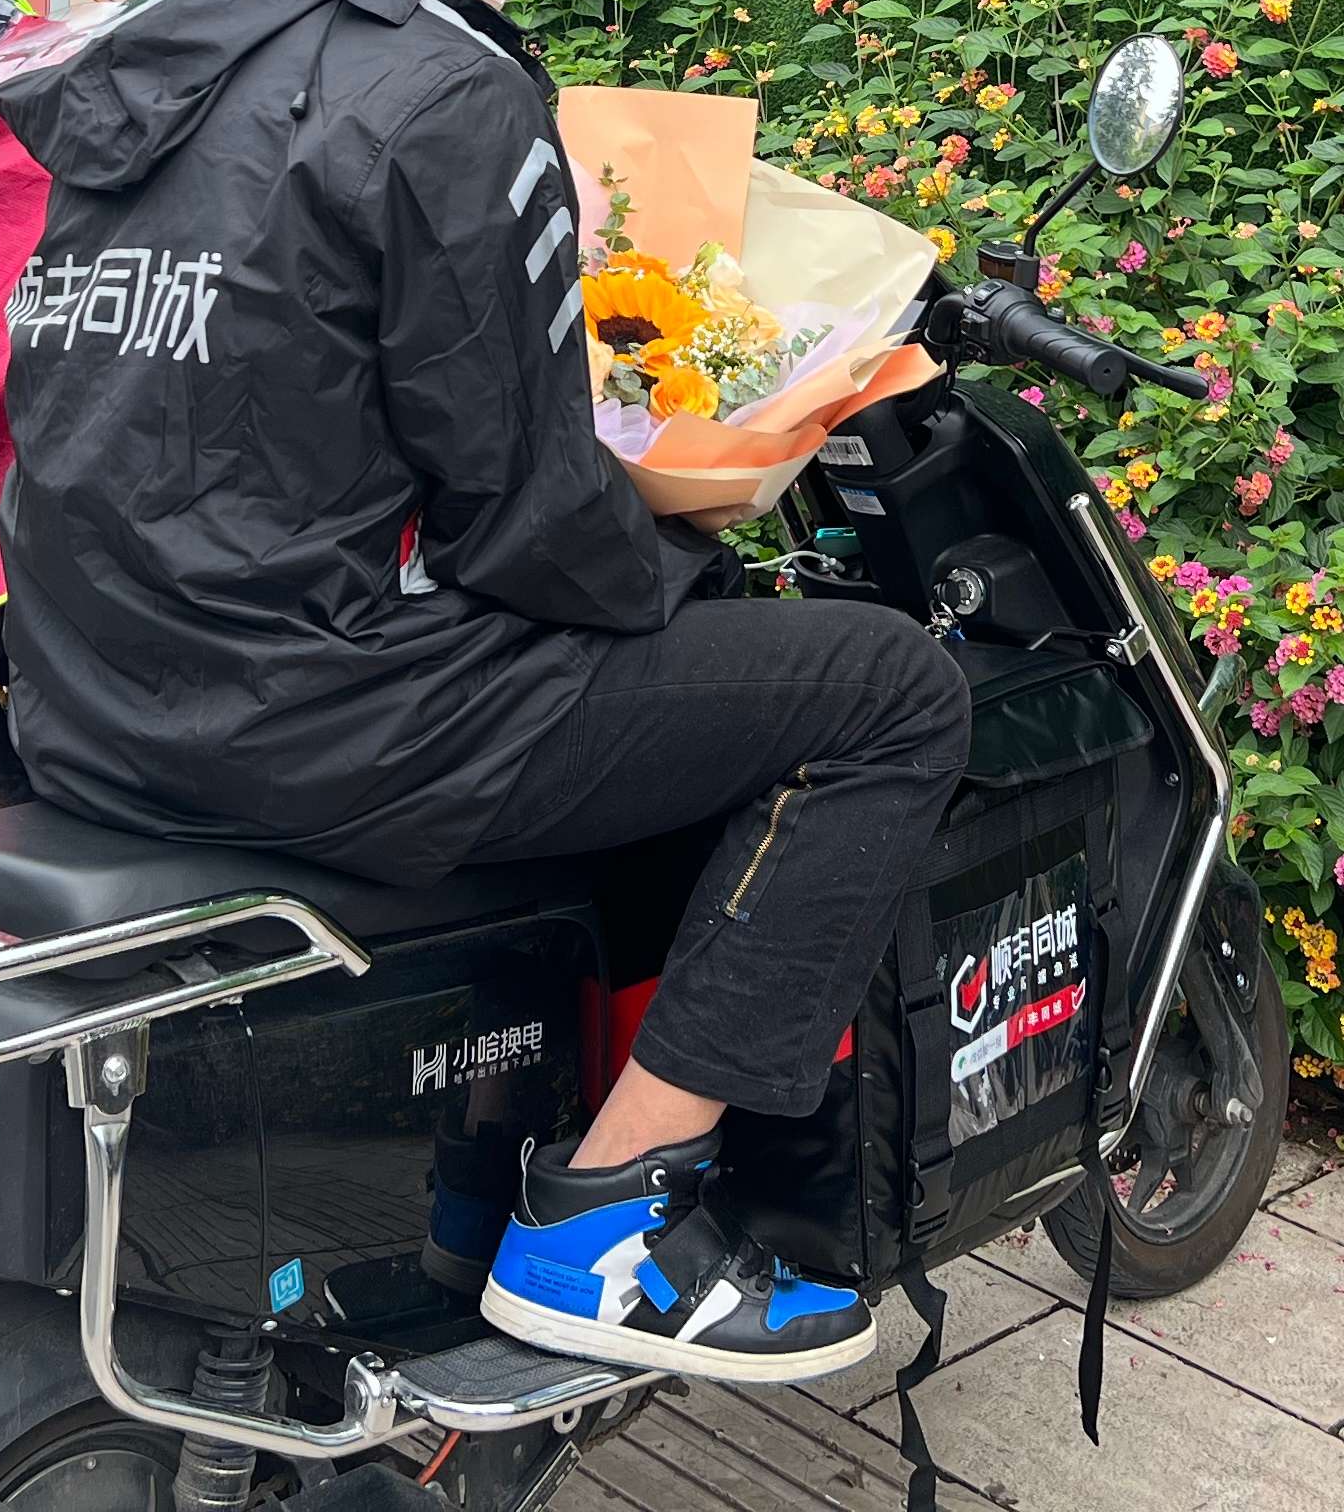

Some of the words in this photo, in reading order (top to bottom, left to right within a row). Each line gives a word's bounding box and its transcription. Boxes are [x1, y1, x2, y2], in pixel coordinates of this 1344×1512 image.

[991, 902, 1079, 990] 顺丰同城
[1018, 999, 1064, 1034] 丰同城
[452, 1021, 543, 1069] 小哈换电
